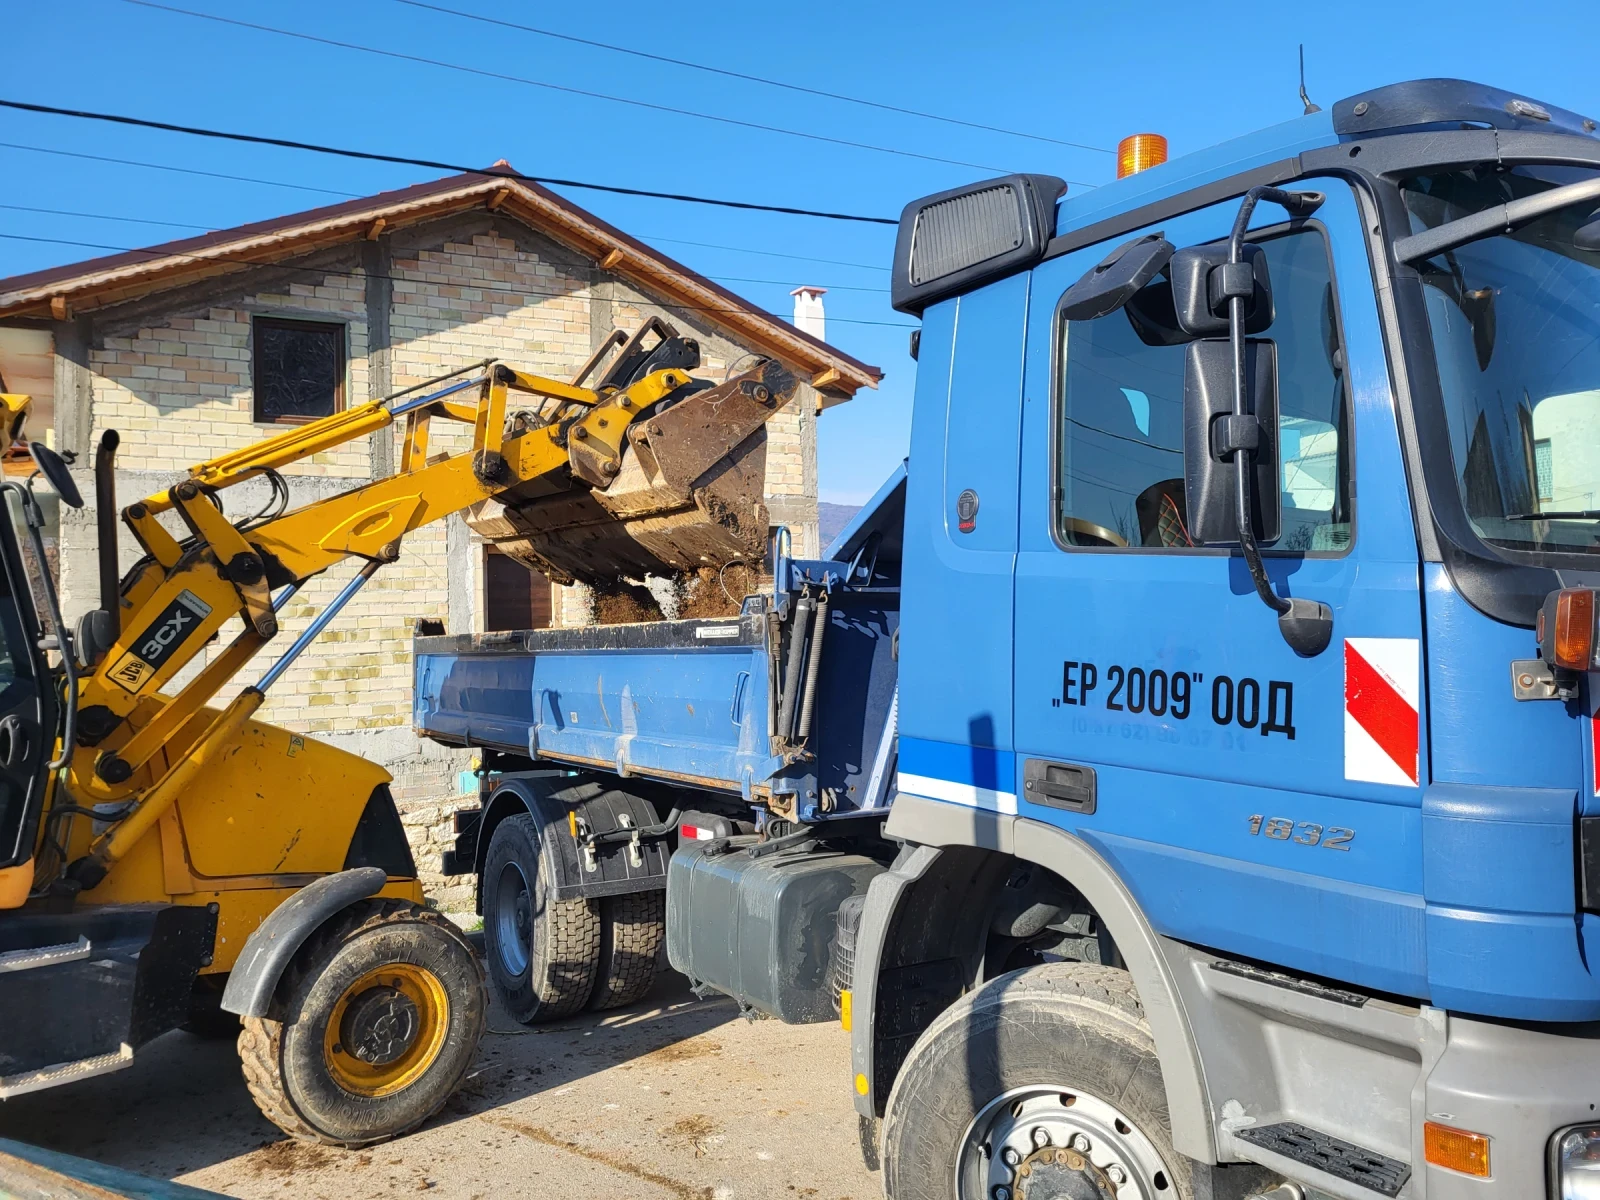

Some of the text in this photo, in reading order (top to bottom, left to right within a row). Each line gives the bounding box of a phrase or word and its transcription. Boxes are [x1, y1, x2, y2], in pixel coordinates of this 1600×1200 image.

[142, 609, 192, 660] 3CX
[119, 662, 143, 681] JCB
[1106, 665, 1203, 720] 2009"
[1211, 675, 1296, 740] ООД
[1248, 814, 1356, 851] 1832
